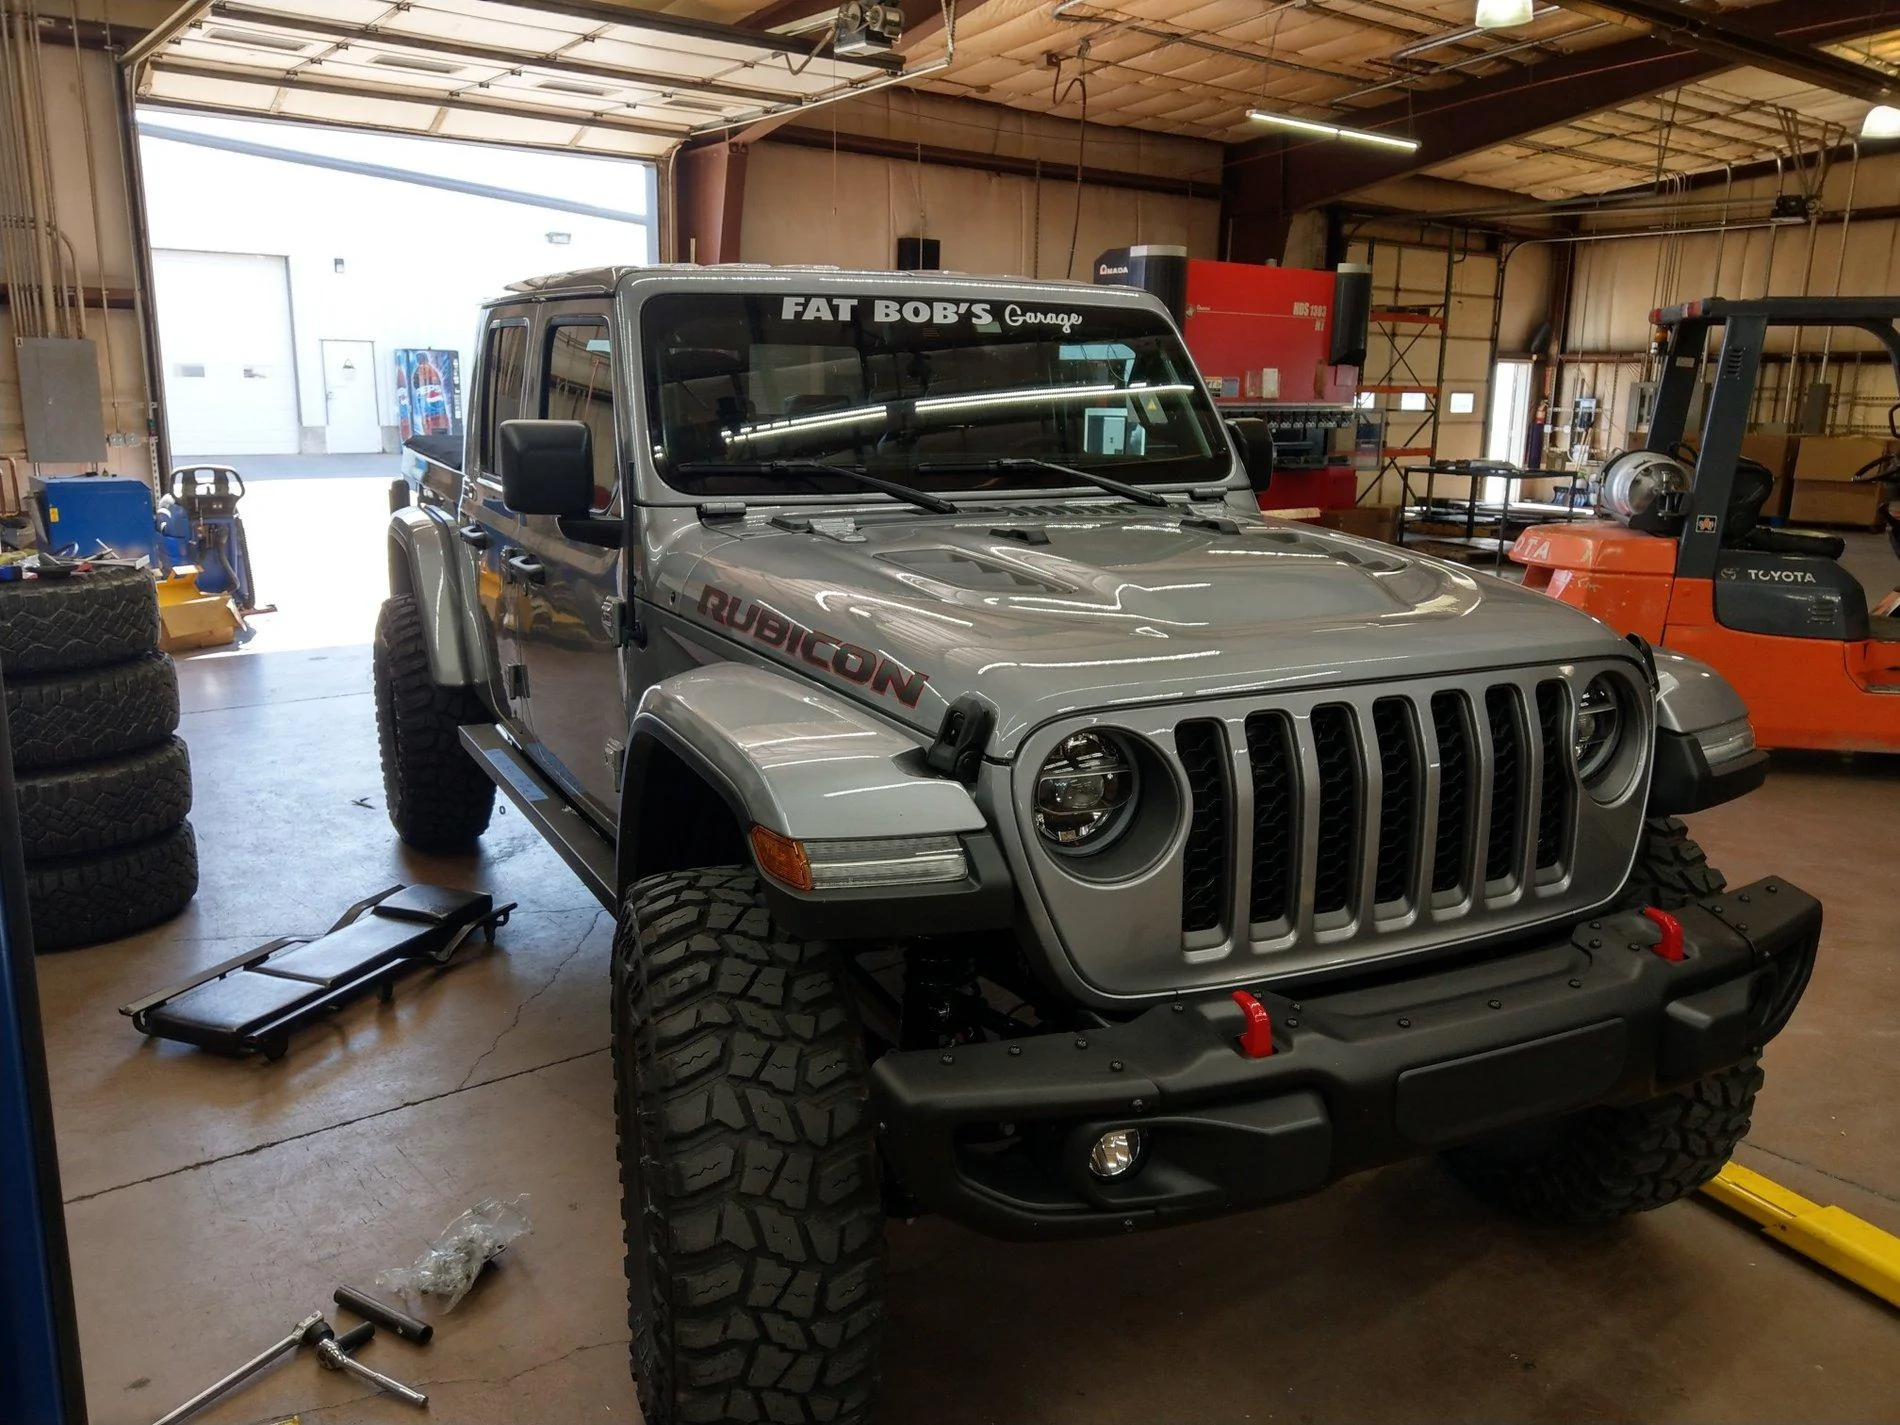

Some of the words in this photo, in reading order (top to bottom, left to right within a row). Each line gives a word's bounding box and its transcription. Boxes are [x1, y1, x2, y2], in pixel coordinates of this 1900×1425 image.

[781, 297, 858, 321] FAT
[874, 300, 993, 323] BOB'S
[1004, 304, 1083, 333] Garage
[1748, 569, 1816, 583] TOYOTA
[697, 584, 930, 710] RUBICON
